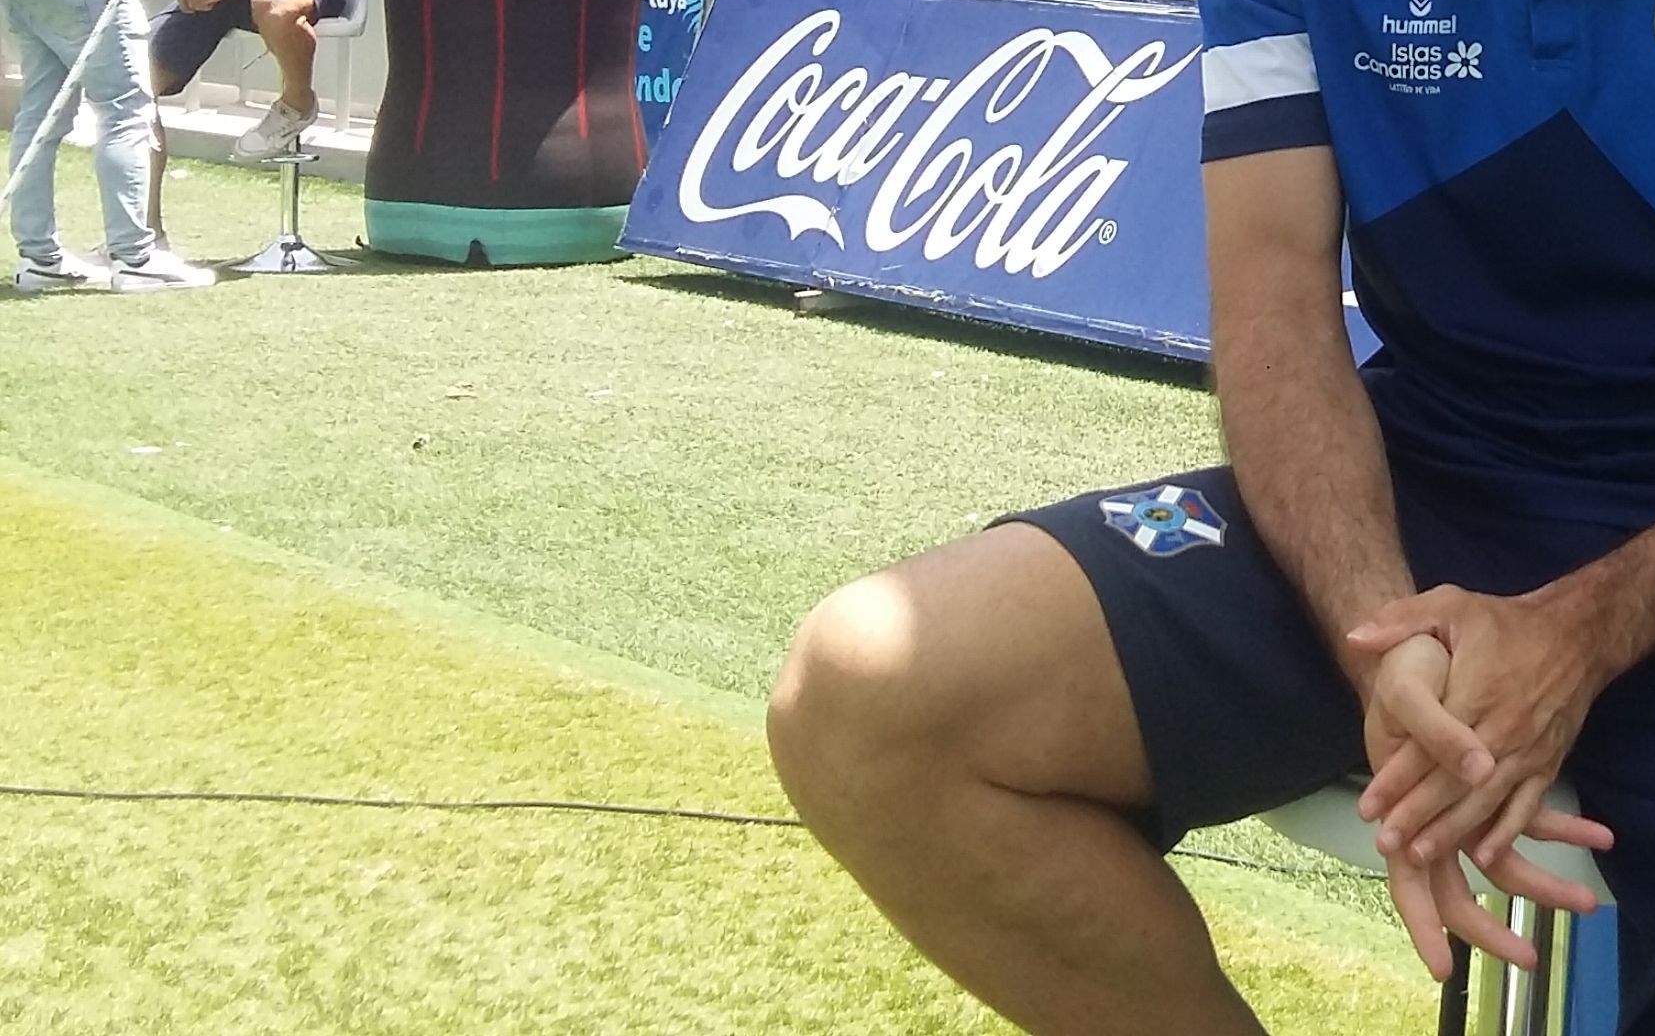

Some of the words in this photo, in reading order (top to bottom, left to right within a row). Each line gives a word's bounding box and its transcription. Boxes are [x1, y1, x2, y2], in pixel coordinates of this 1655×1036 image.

[1383, 14, 1457, 34] hummel
[1392, 42, 1442, 63] Islas
[1354, 52, 1442, 81] Canarias
[678, 9, 1203, 279] Coca-Cola
